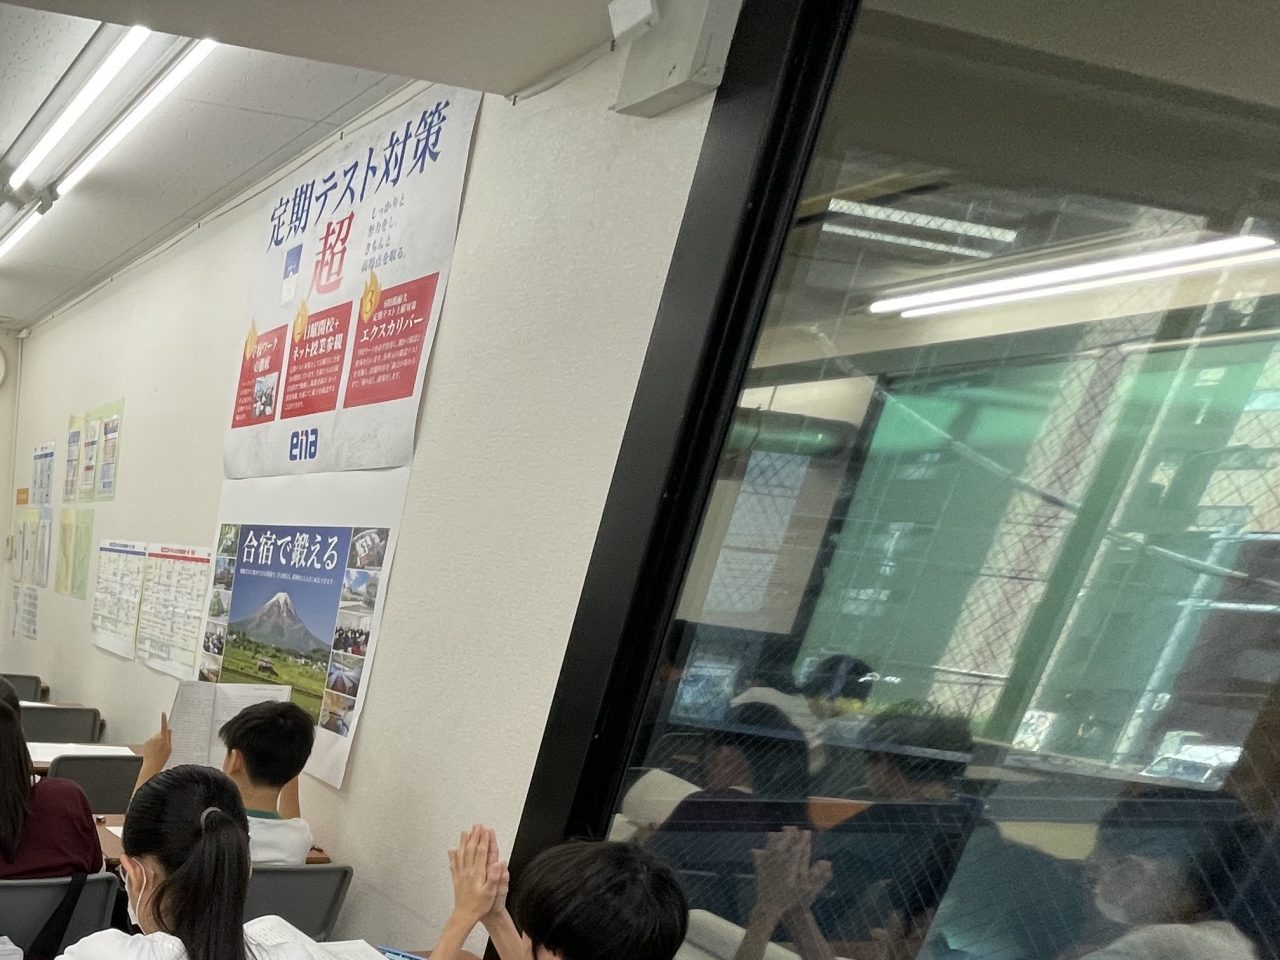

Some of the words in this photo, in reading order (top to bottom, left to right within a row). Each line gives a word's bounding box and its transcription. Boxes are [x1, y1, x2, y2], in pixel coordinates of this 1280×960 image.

[266, 100, 450, 254] 定期テスト対策
[310, 210, 355, 294] 超
[292, 333, 343, 361] ネット授業参観
[360, 314, 423, 342] エクスカリバー
[289, 427, 319, 461] ena
[242, 529, 340, 571] 合宿で鍛える
